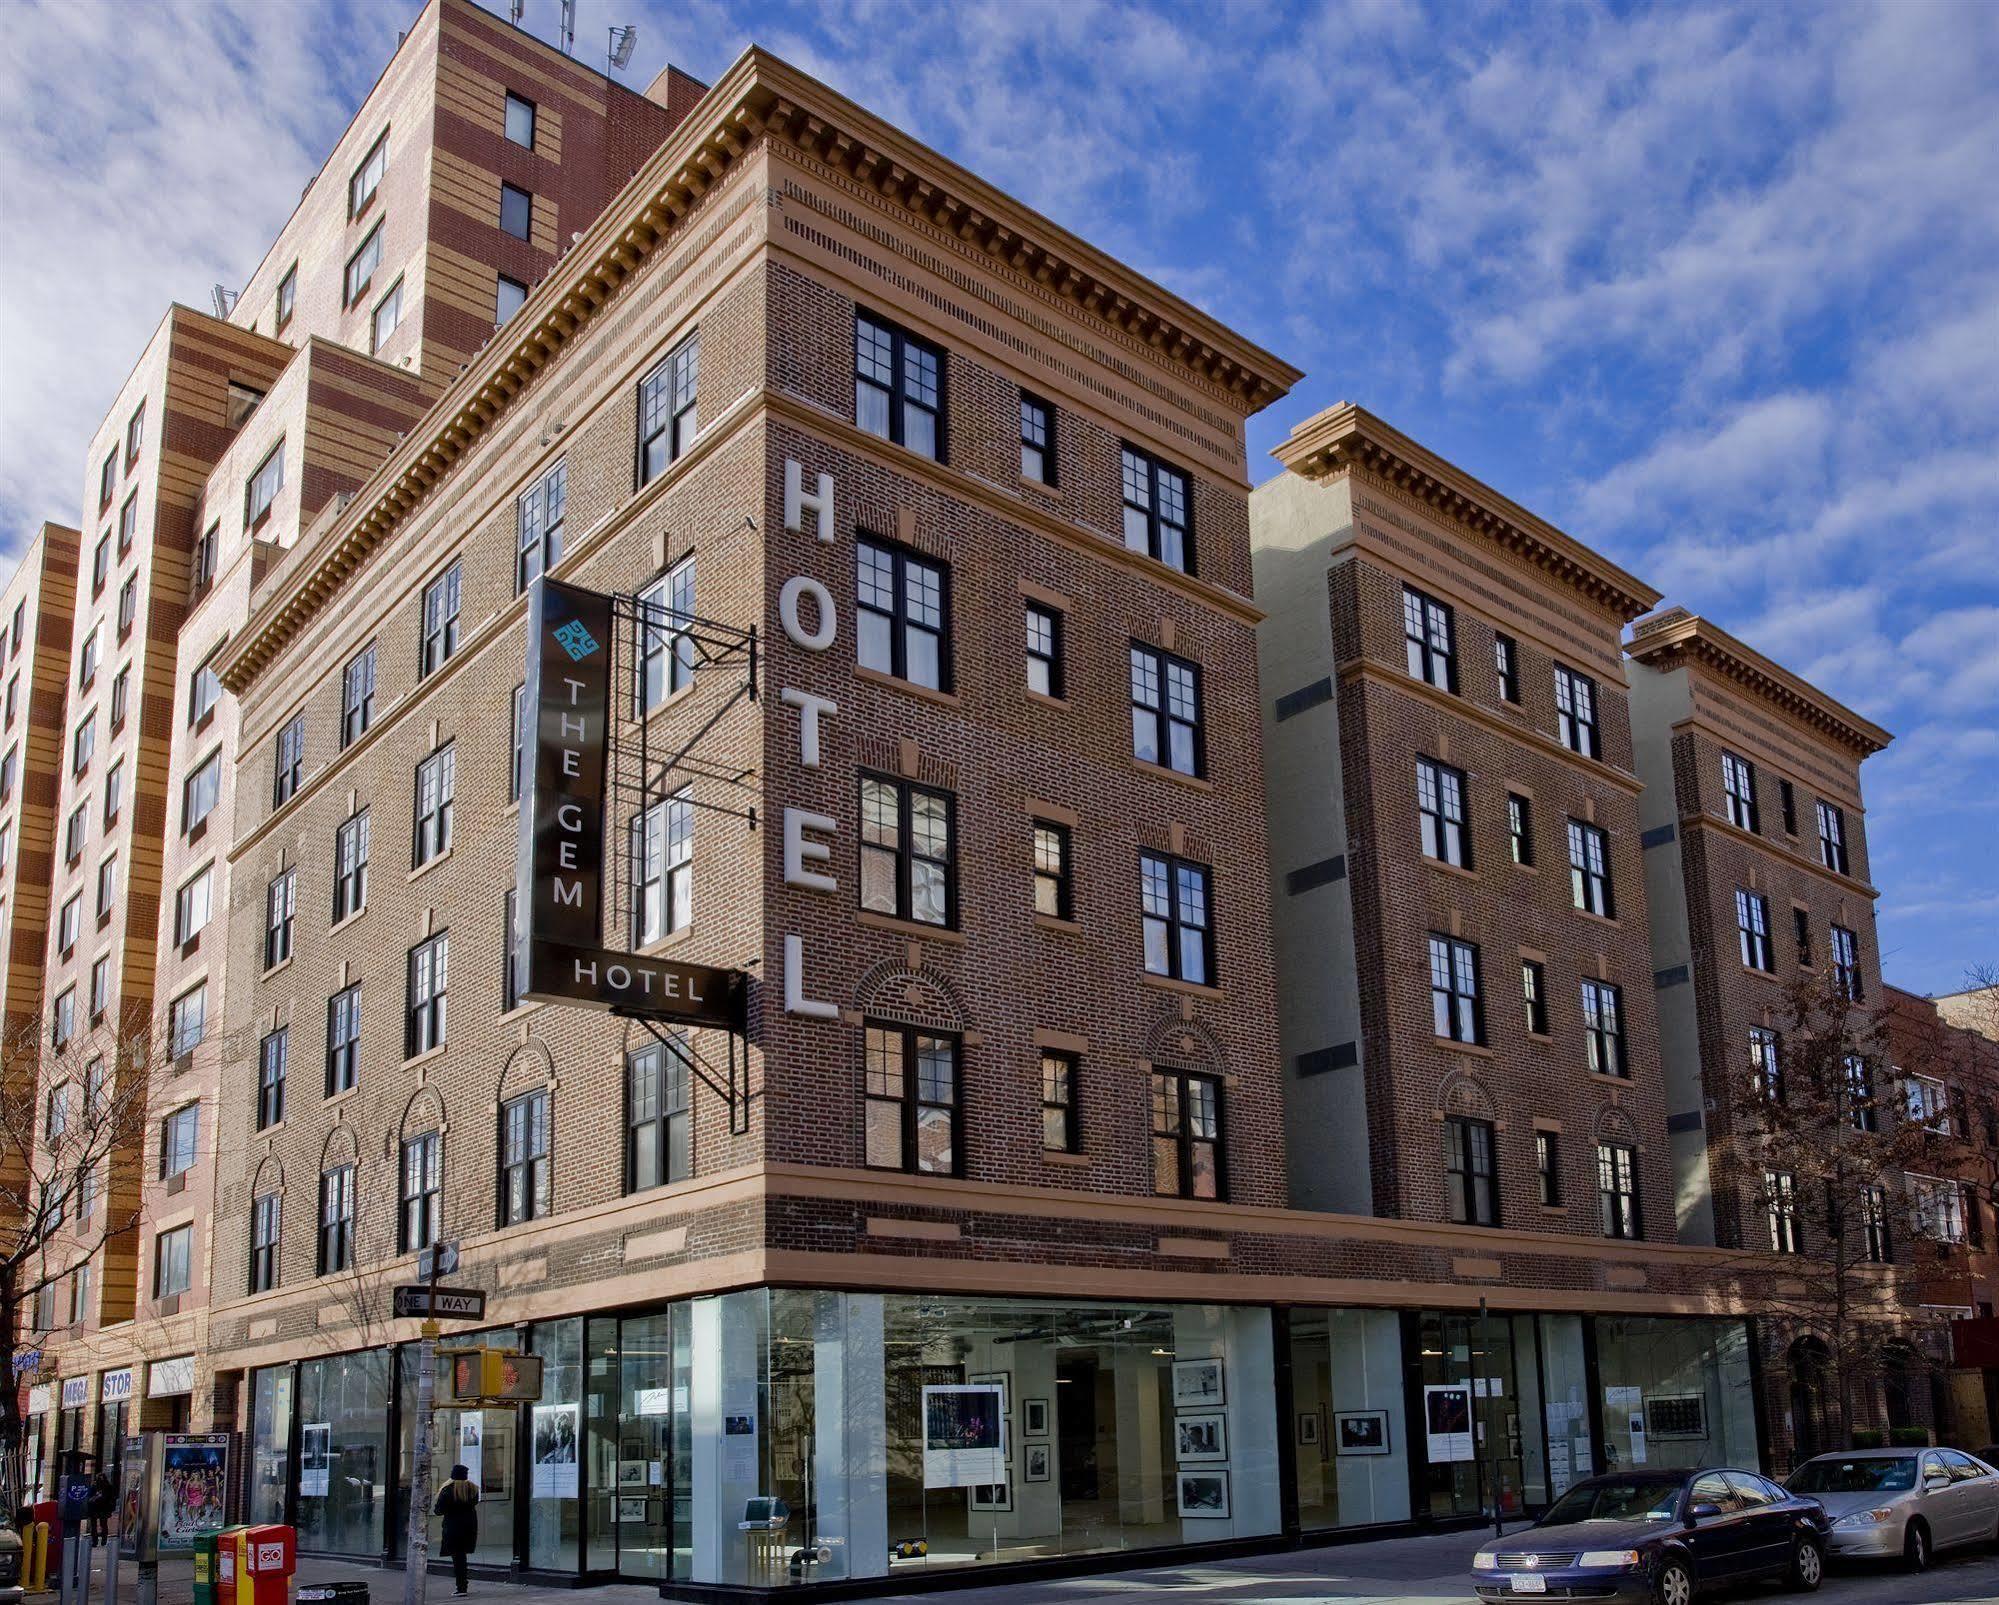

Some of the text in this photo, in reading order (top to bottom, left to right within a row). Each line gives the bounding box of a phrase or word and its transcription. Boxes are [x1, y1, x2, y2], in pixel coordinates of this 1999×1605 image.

[779, 458, 838, 1018] HOTEL
[553, 677, 586, 908] THE GEM
[575, 958, 703, 1002] HOTEL
[397, 1295, 473, 1311] ONE WAY
[261, 1549, 281, 1562] GO
